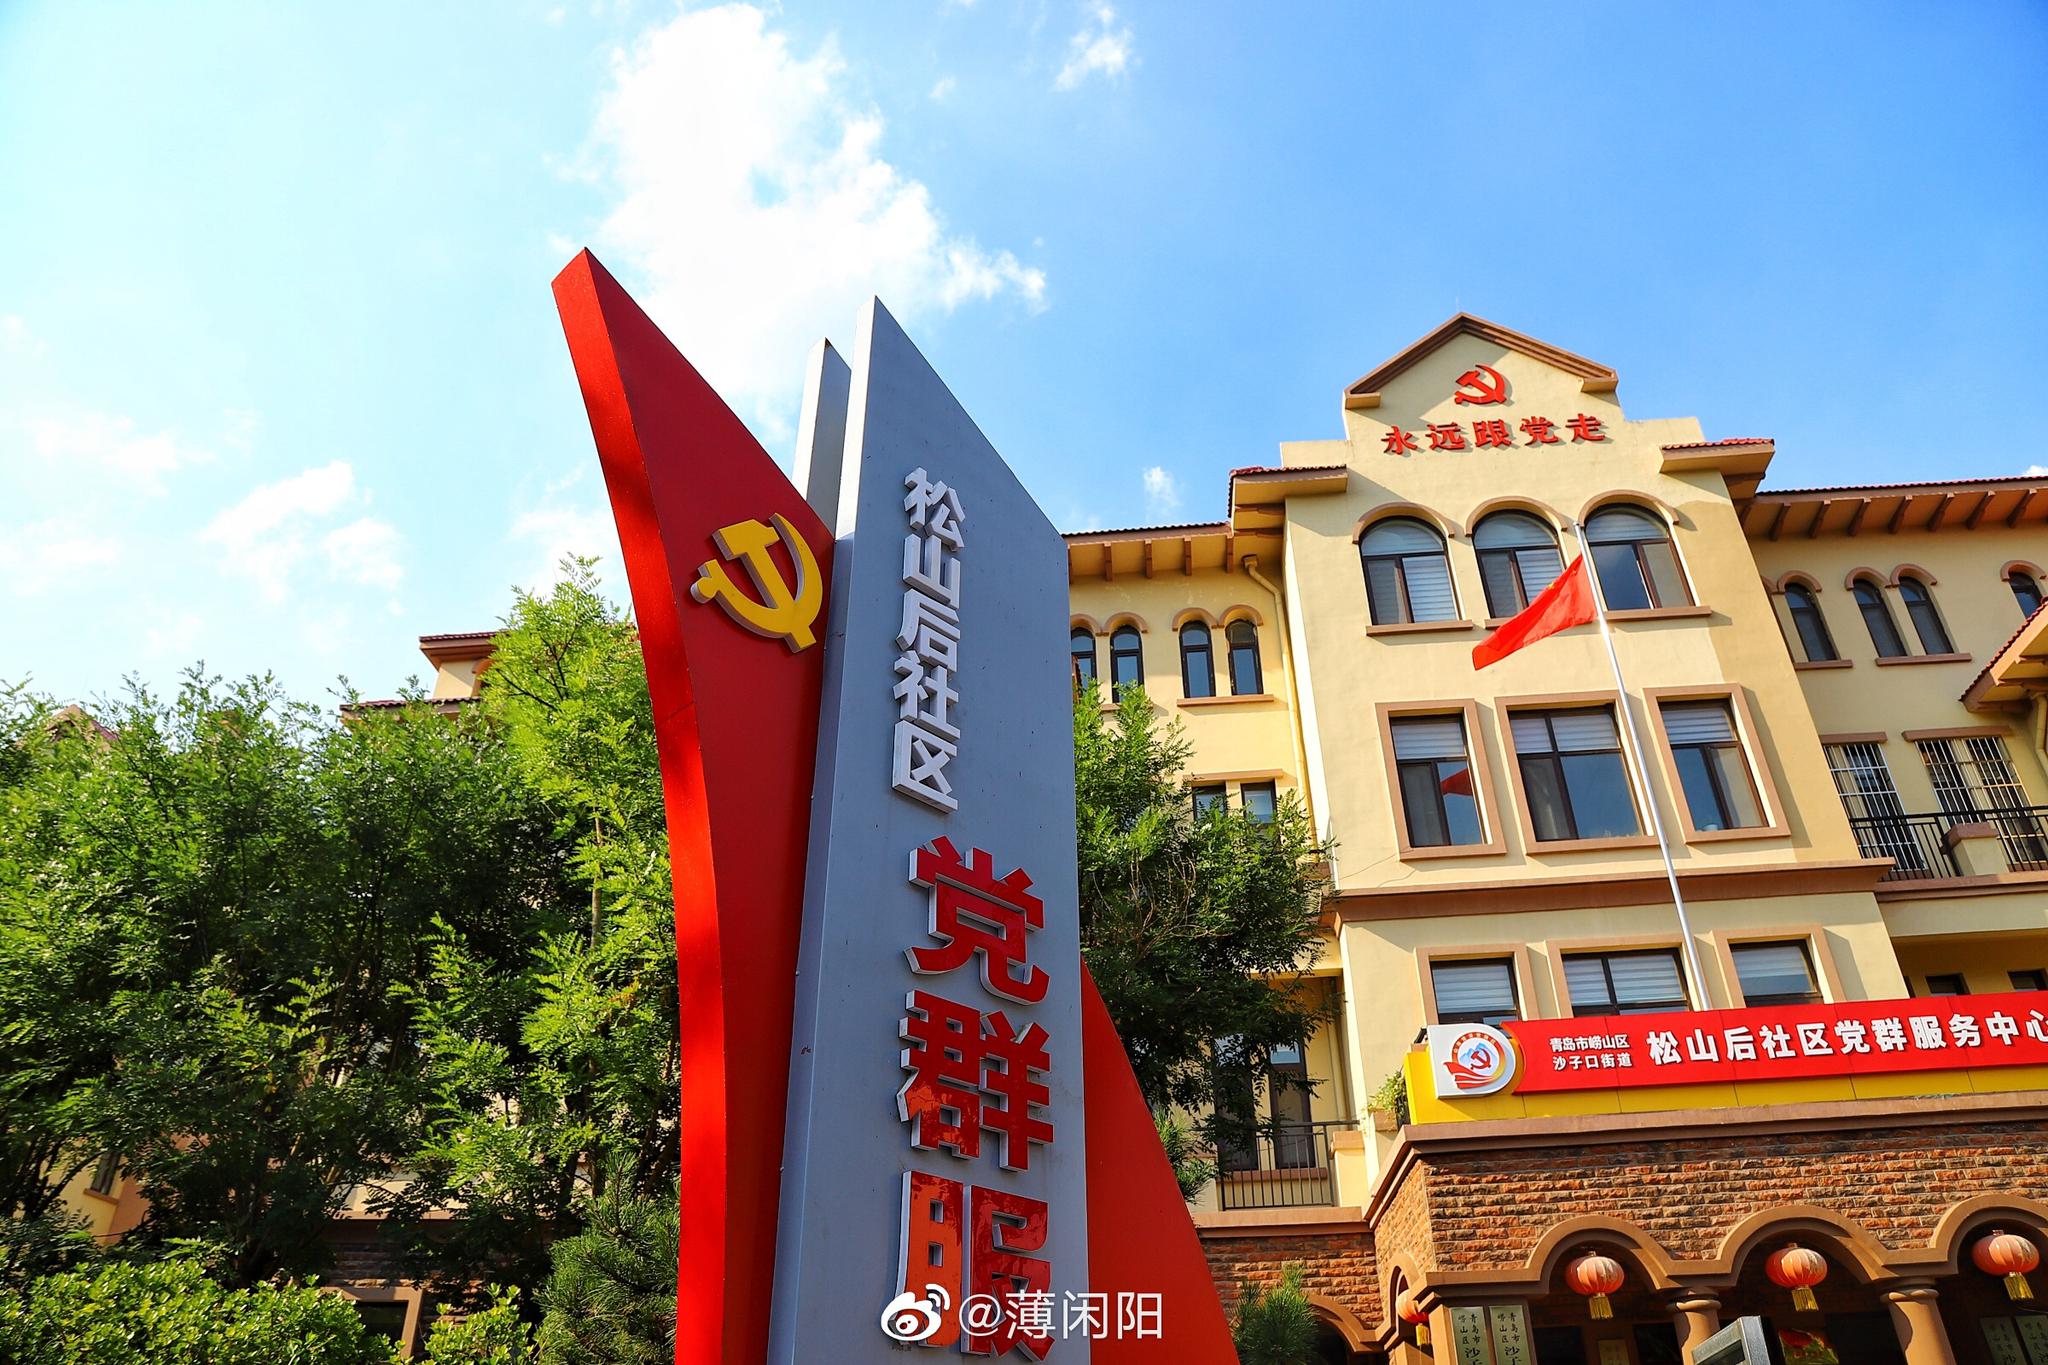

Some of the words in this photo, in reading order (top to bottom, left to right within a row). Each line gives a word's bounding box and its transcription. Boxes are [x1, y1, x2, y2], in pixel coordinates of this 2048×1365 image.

[1381, 413, 1605, 455] 永远跟党走
[892, 467, 965, 814] 松山后社区
[1550, 1034, 1630, 1052] 青岛市崂山区
[1553, 1052, 1633, 1070] 沙子口街道
[896, 835, 1055, 1361] 党群服
